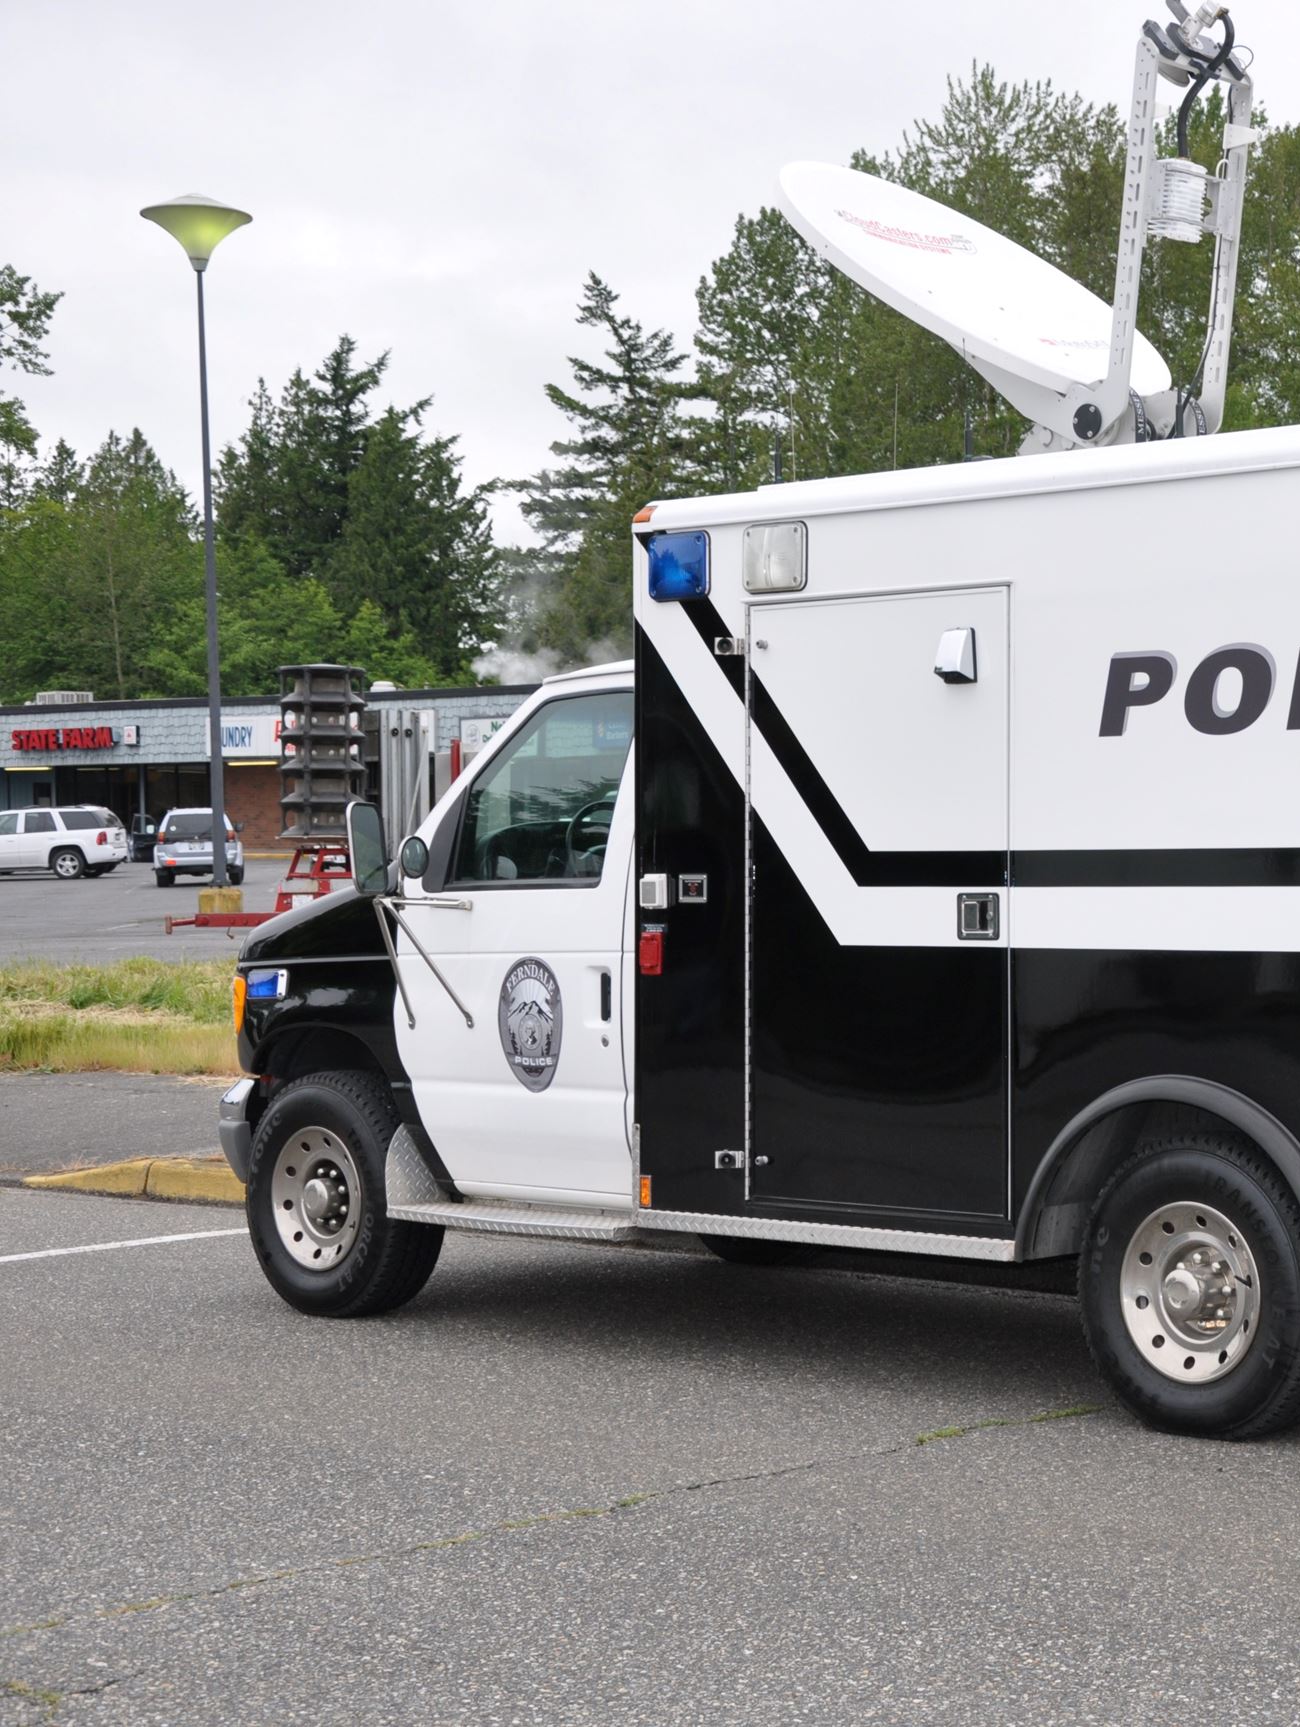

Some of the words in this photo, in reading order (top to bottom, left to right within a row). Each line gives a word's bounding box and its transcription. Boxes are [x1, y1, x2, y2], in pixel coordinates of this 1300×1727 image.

[12, 729, 58, 751] STATE
[62, 727, 113, 749] FARM
[221, 725, 252, 748] UNDRY
[506, 964, 556, 997] FERNDALE
[514, 1055, 553, 1067] POLICE
